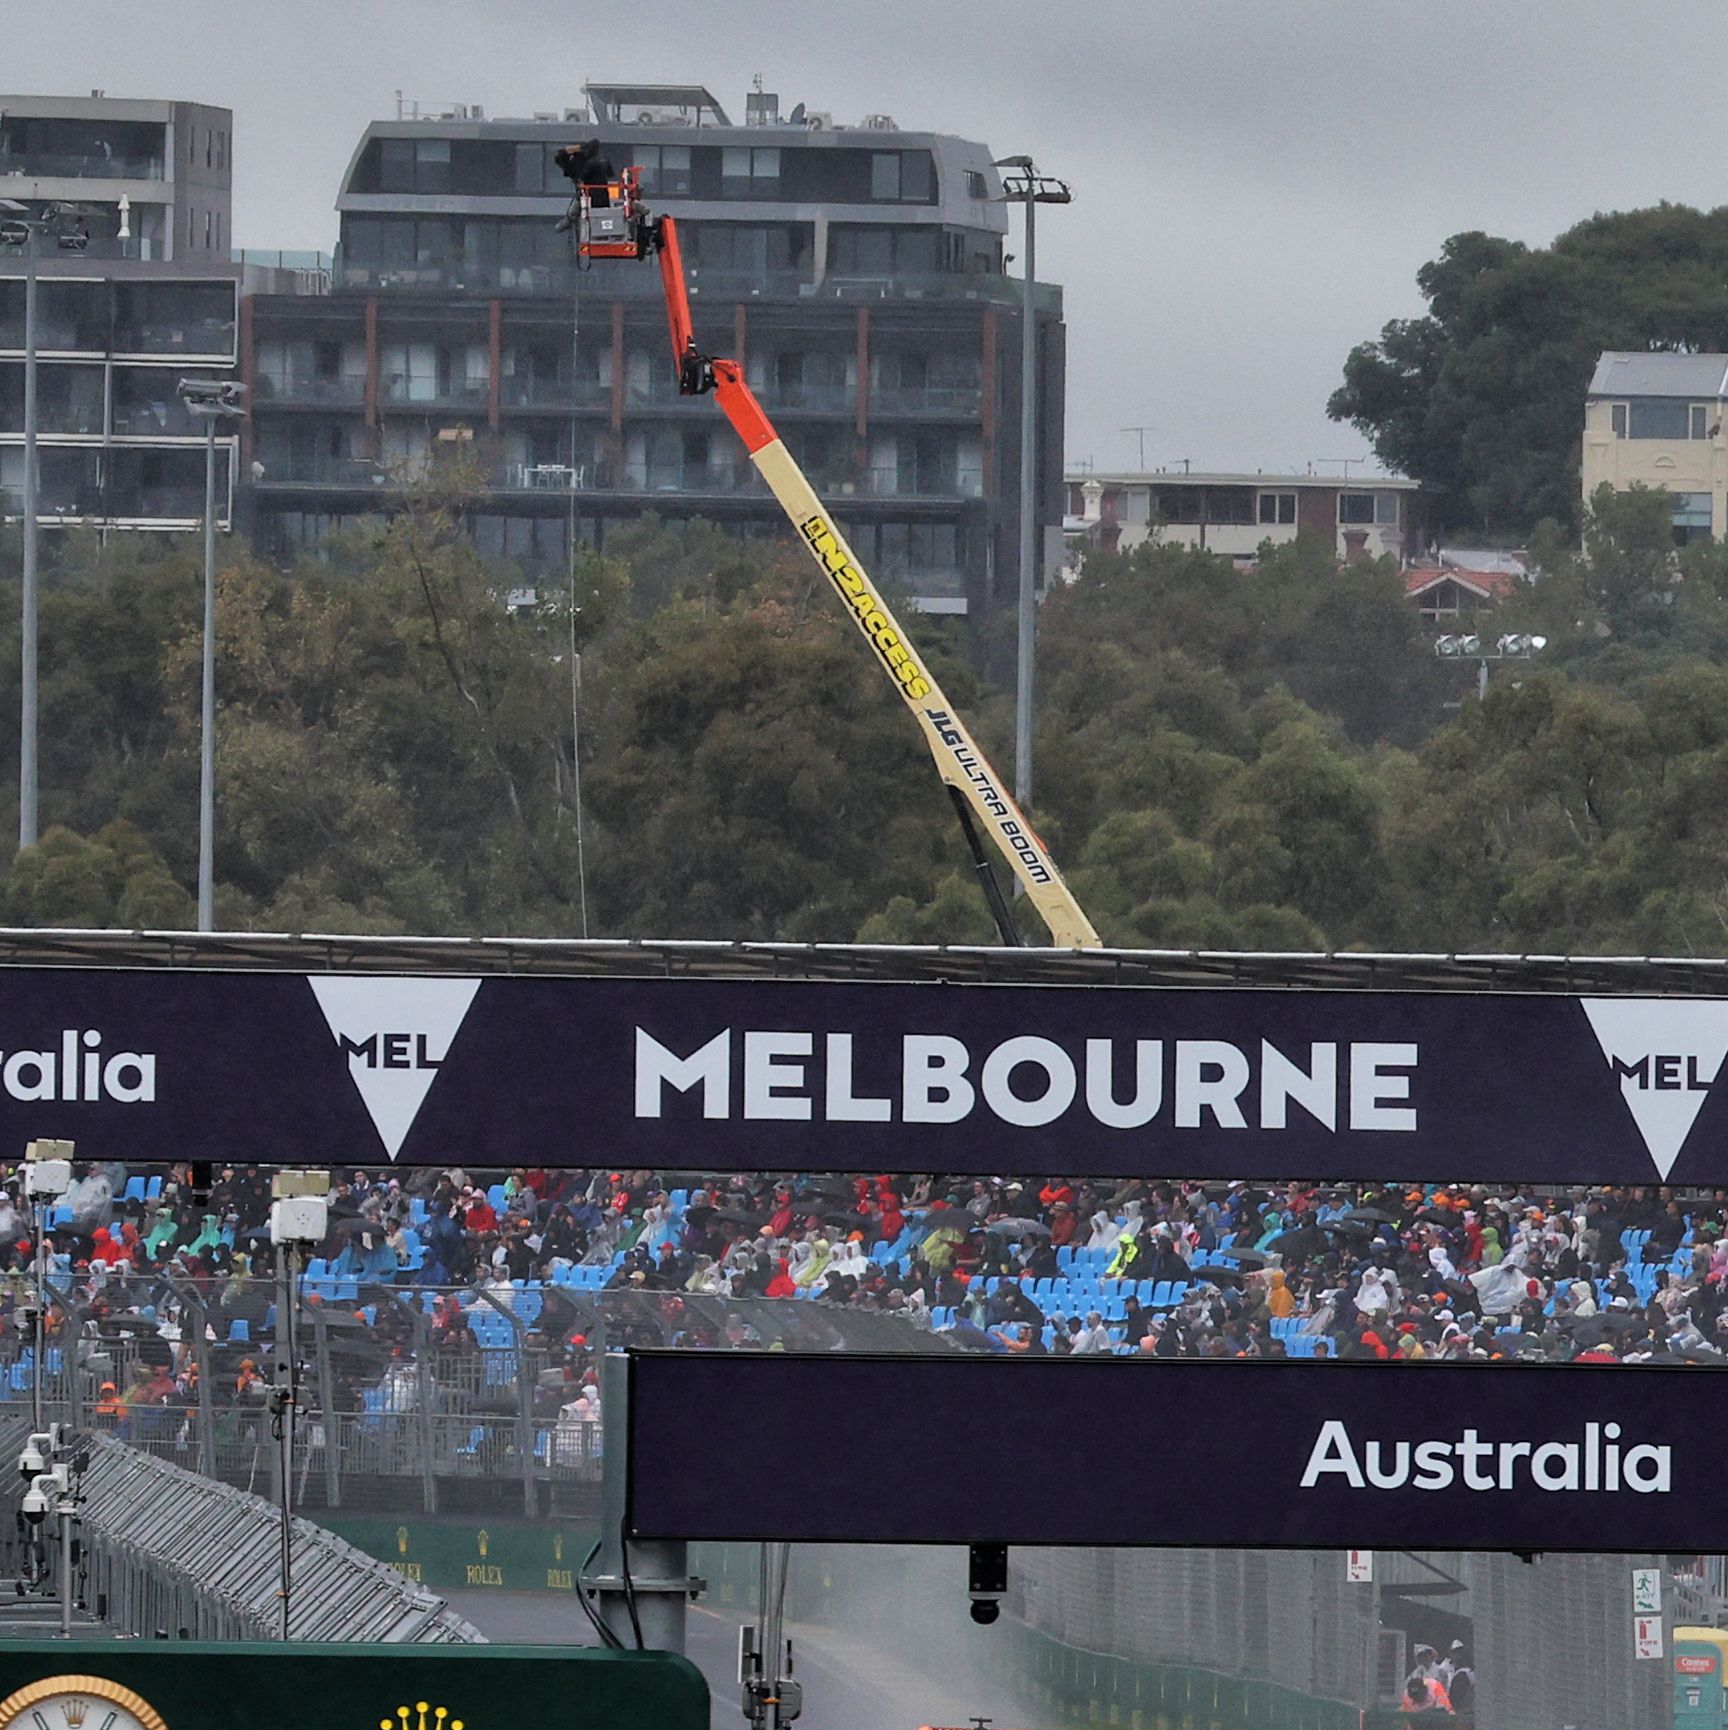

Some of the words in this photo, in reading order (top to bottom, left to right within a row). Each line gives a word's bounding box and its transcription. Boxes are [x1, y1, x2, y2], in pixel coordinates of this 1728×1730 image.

[924, 708, 963, 746] JLG
[953, 747, 1008, 816] ULTRA
[1000, 821, 1052, 886] BOOM
[0, 1030, 155, 1102] alia
[340, 1033, 443, 1069] MEL
[635, 1026, 1418, 1132] MELBOURNE
[1613, 1055, 1713, 1091] MEL
[1300, 1420, 1671, 1492] Australia
